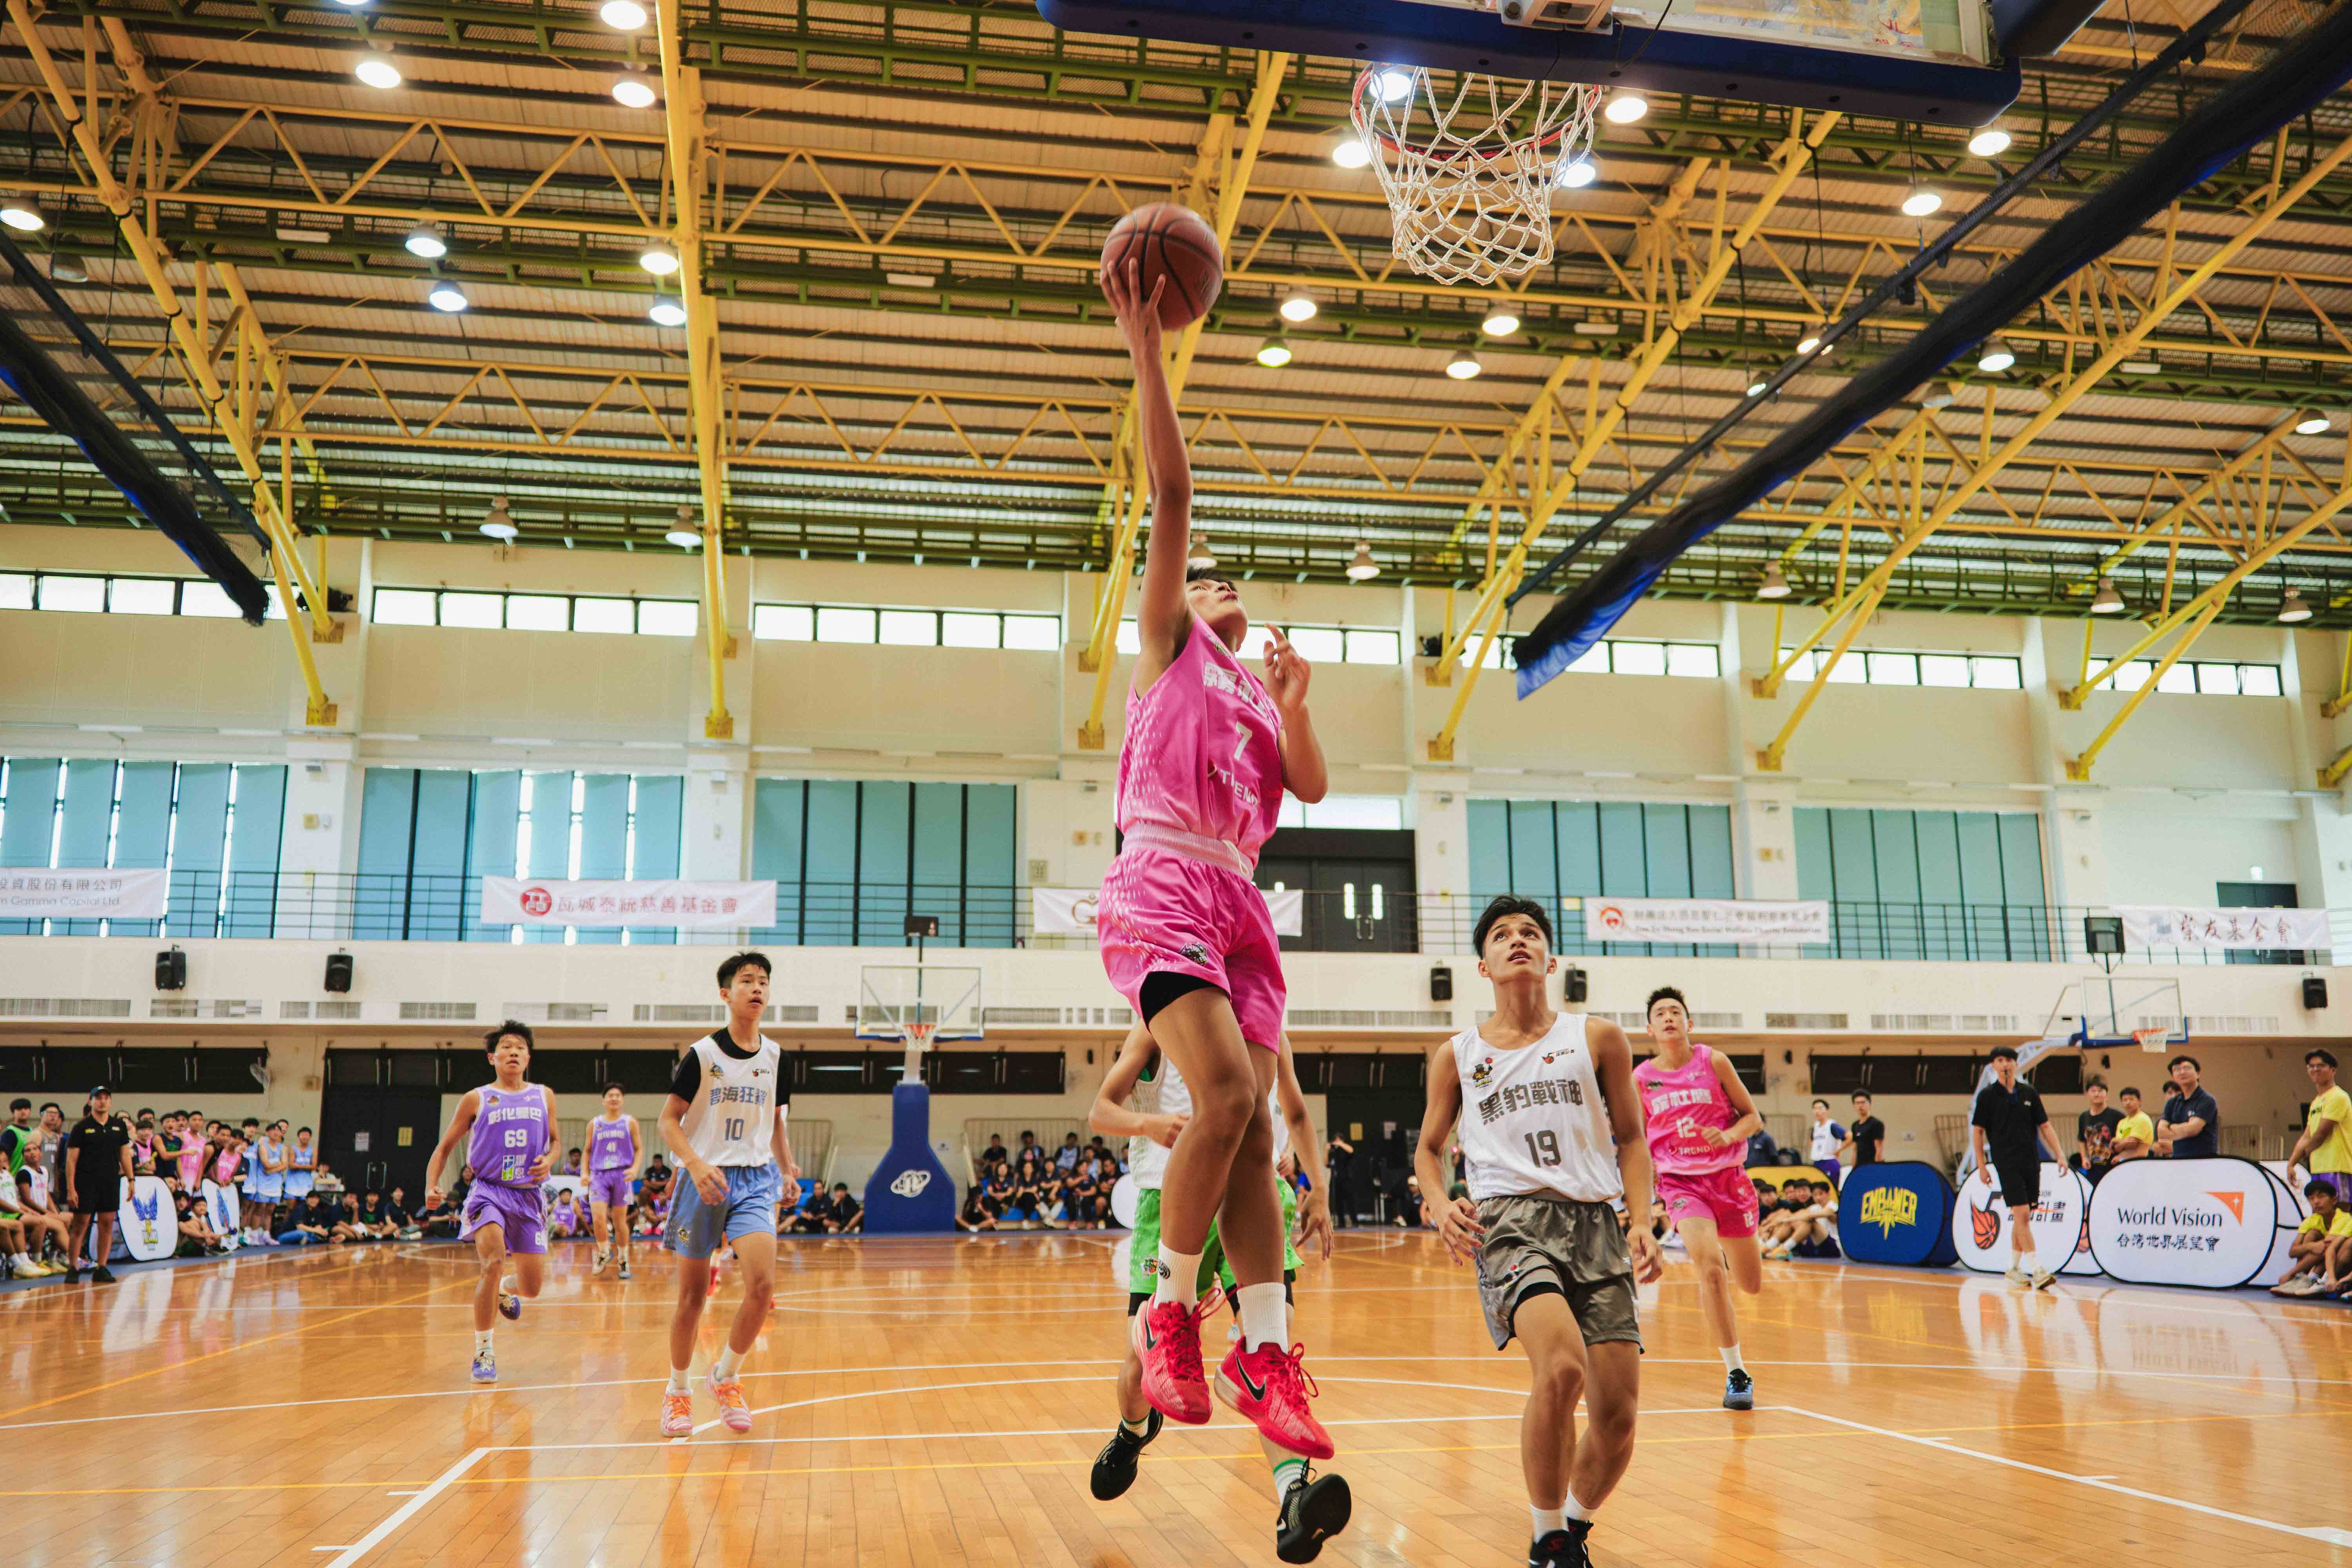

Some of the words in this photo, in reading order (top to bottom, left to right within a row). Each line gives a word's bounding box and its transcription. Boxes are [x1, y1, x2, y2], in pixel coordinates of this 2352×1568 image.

[1234, 720, 1253, 762] 7
[60, 896, 100, 906] Capital
[557, 895, 738, 914] 瓦城泰統慈善基金會
[1478, 1079, 1583, 1126] 黑豹戰神
[725, 1118, 744, 1141] 10
[1676, 1116, 1697, 1138] 12
[505, 1129, 527, 1148] 69
[1524, 1129, 1561, 1168] 19
[2118, 1205, 2166, 1225] World
[2172, 1207, 2223, 1227] Vision
[2117, 1232, 2220, 1252] 台灣世界展望會
